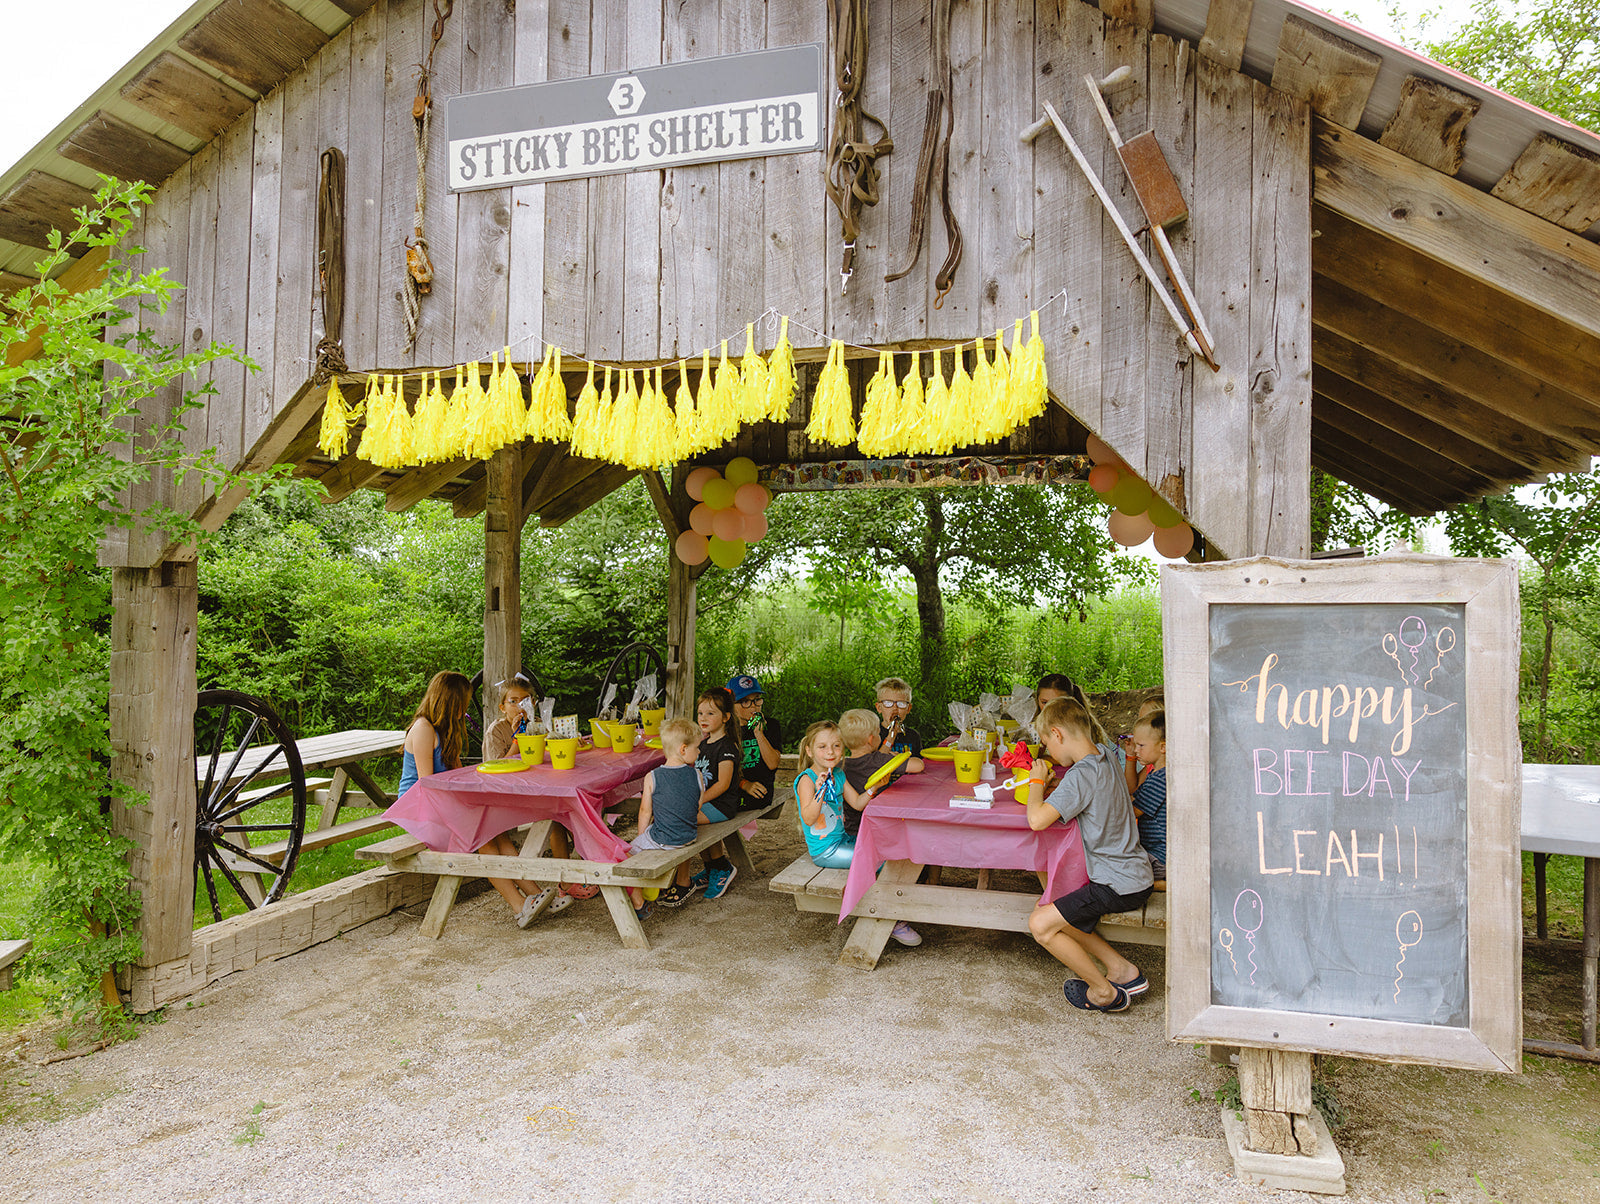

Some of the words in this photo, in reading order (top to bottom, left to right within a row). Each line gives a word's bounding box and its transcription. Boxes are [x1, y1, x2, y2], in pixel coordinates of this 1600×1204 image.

[619, 83, 633, 110] 3
[459, 132, 572, 181] STICKY
[581, 124, 640, 165] BEE
[648, 101, 804, 158] SHELTER
[1222, 653, 1457, 756] happy
[1253, 748, 1331, 796] BEE
[1342, 751, 1422, 801] DAY
[1257, 811, 1418, 888] LEAH!!
